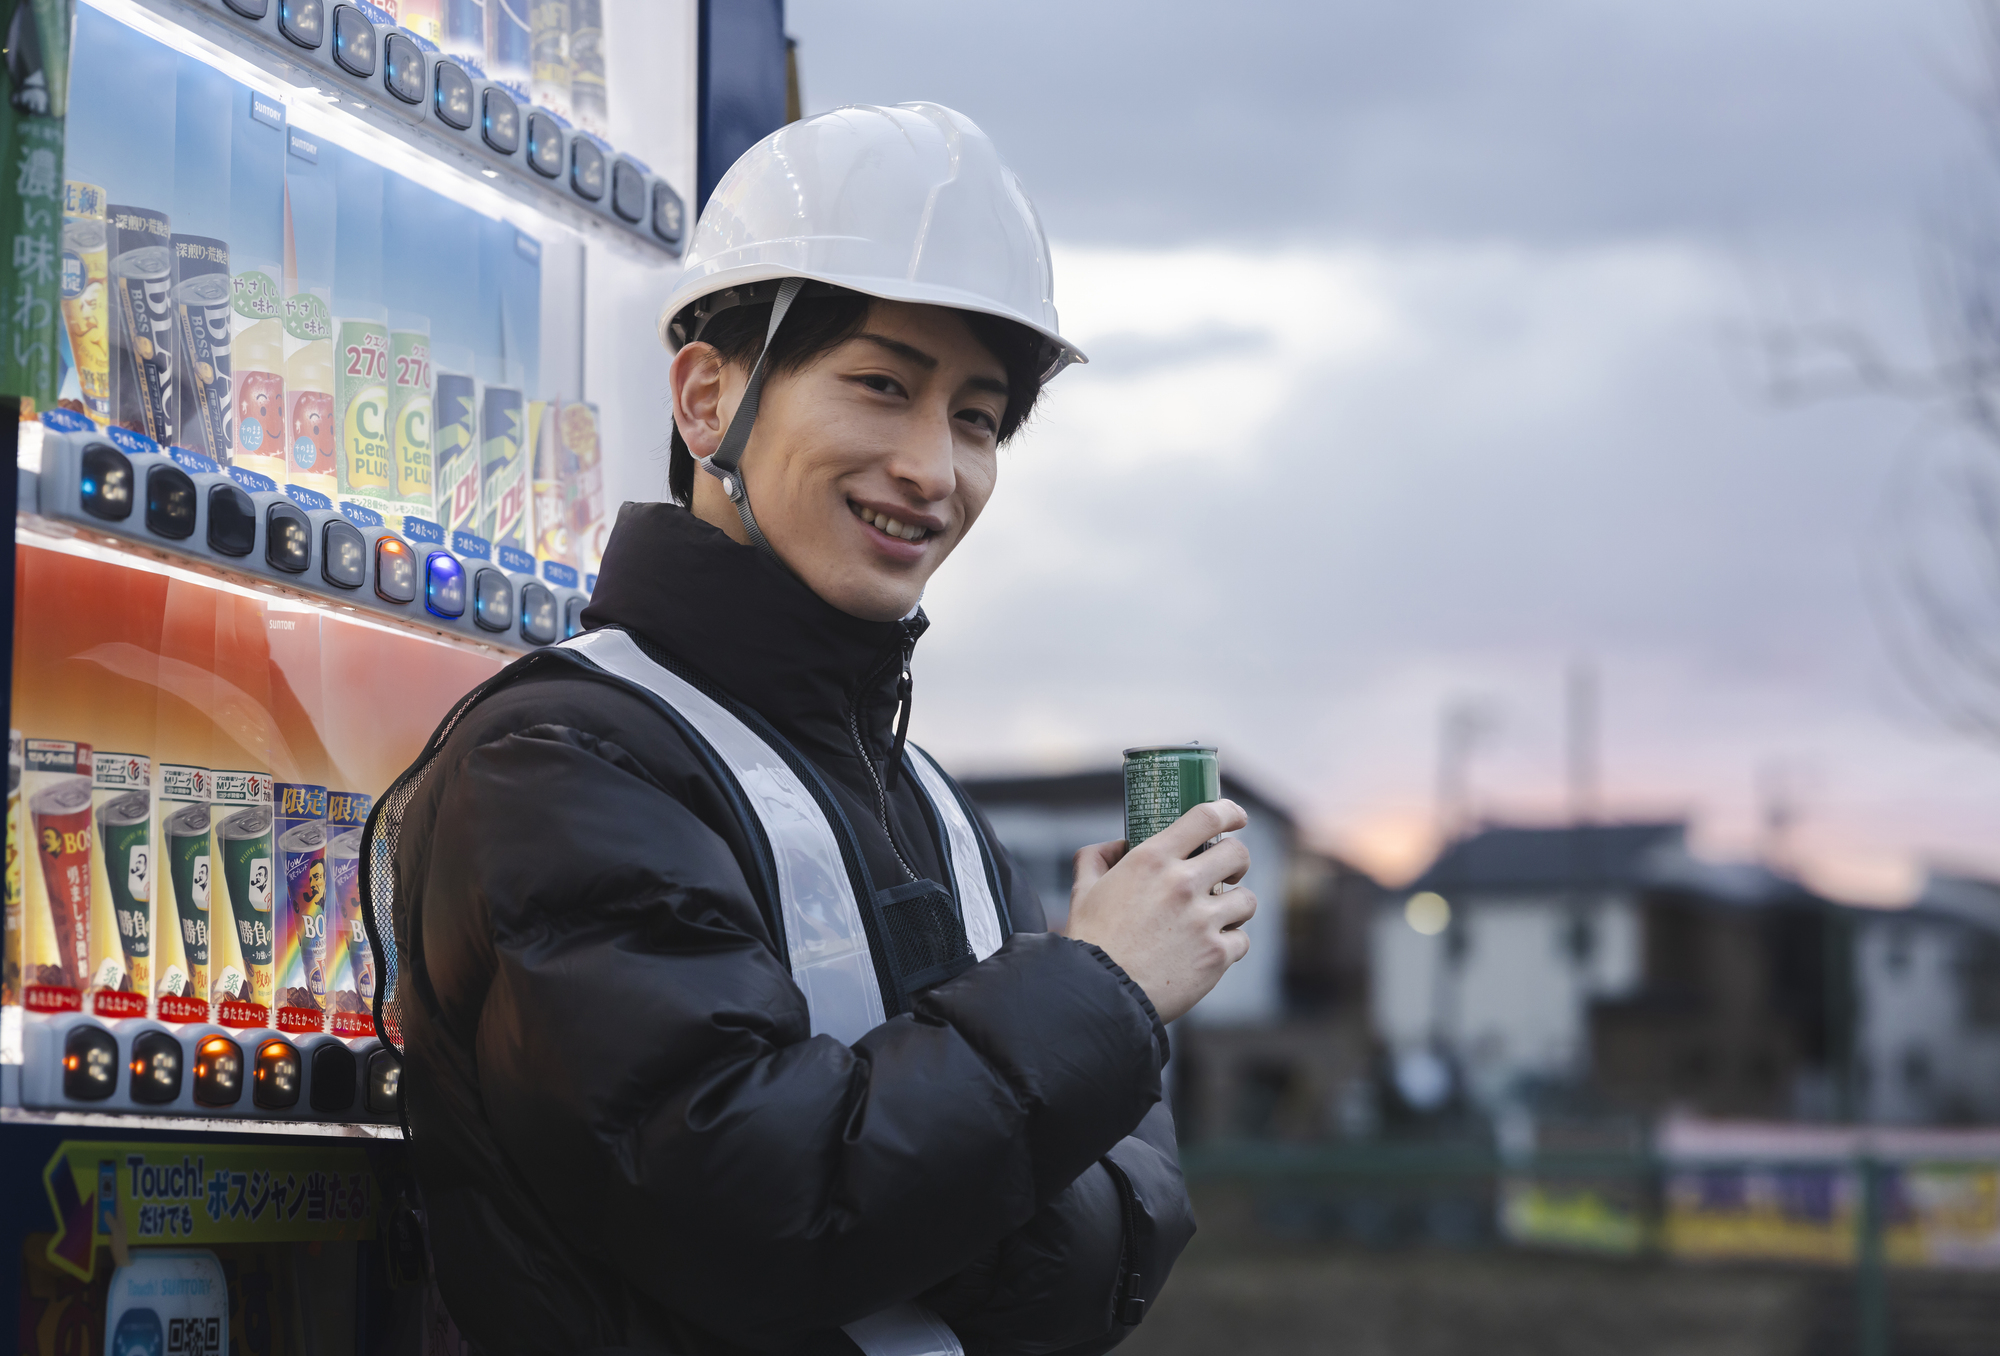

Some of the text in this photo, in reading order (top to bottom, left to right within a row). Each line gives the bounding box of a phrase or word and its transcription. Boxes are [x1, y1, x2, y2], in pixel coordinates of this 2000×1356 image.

[255, 101, 282, 121] SUNTORY
[291, 136, 317, 155] SUNTORY
[131, 289, 149, 333] BOSS
[191, 316, 210, 358] BOSS
[144, 277, 171, 438] BLAC
[347, 346, 387, 379] 270
[204, 305, 233, 461] BLAC
[242, 434, 261, 446] りんご
[296, 452, 315, 464] りんご
[269, 619, 295, 630] SUNTORY
[96, 765, 126, 775] Mリーグ
[164, 776, 192, 787] Mリーグ
[216, 782, 246, 791] Mリーグ
[281, 788, 326, 816] 限定
[182, 918, 208, 946] 勝負
[222, 1006, 264, 1021] あたたか〜い
[281, 1012, 320, 1027] あたたか〜い
[127, 1154, 204, 1200] Touch!
[206, 1172, 371, 1223] ボスジャン当たる!
[139, 1205, 193, 1236] だけでも
[161, 1278, 214, 1298] SUNTORY
